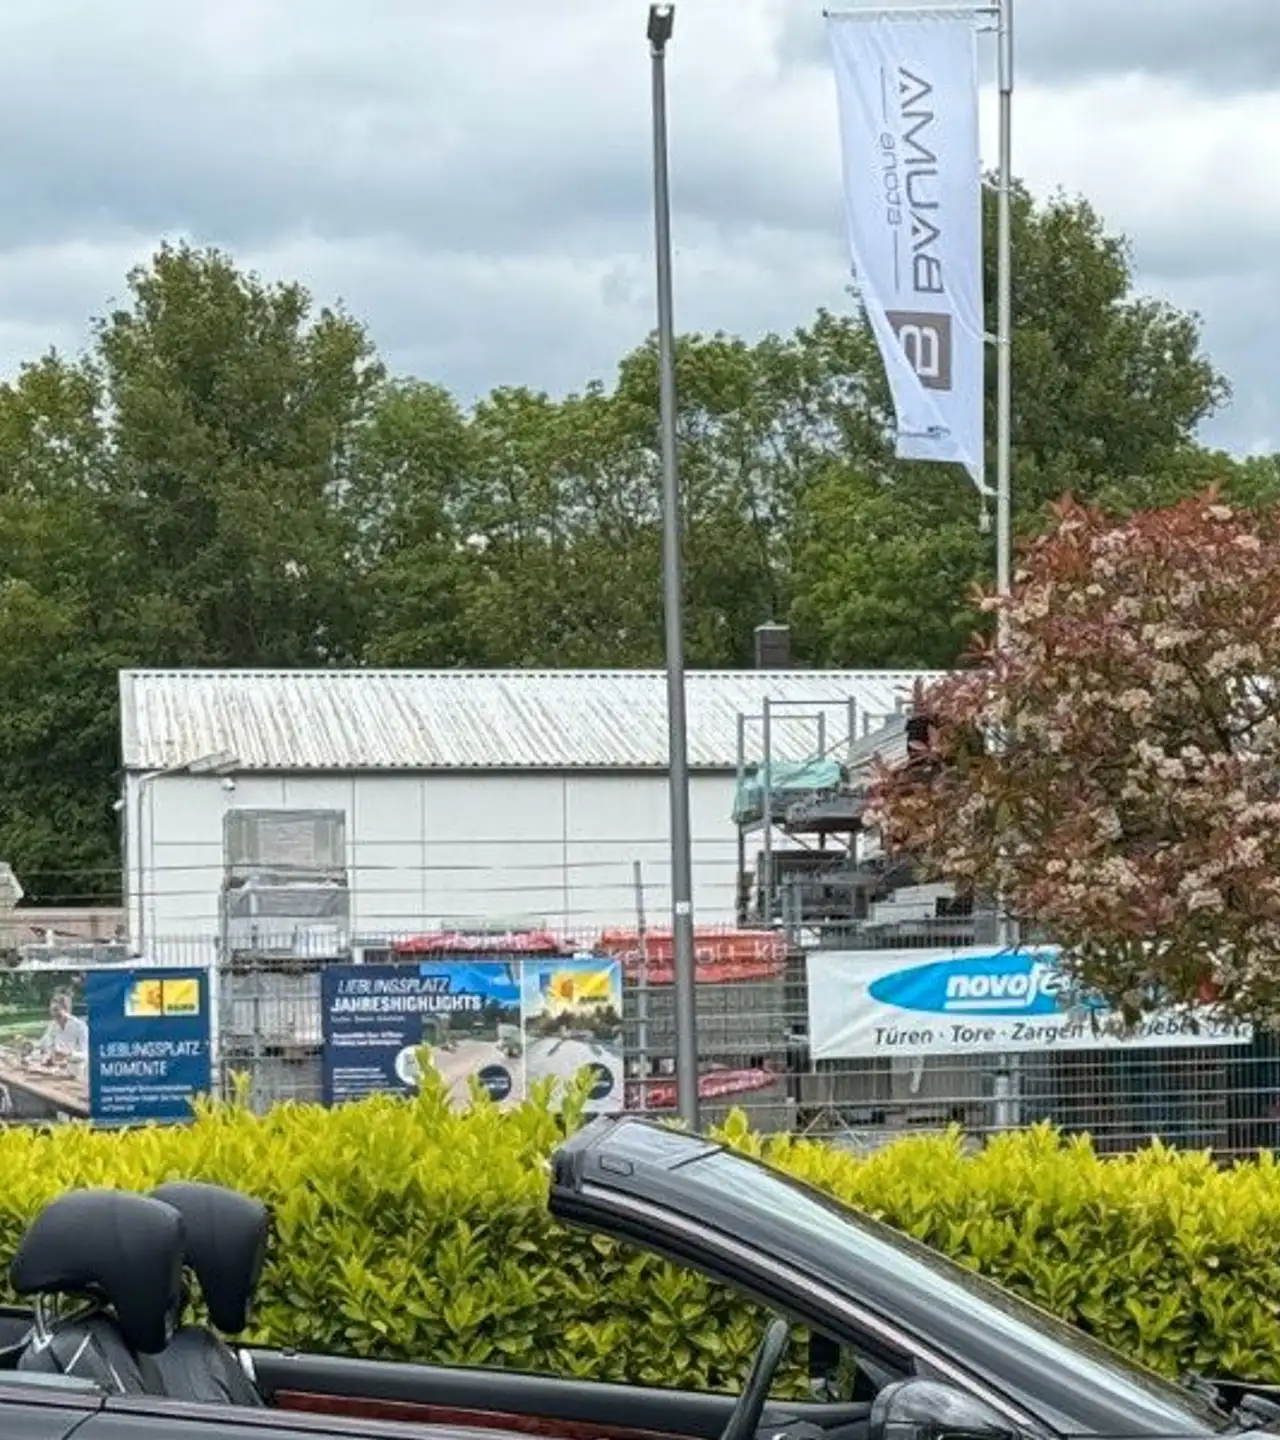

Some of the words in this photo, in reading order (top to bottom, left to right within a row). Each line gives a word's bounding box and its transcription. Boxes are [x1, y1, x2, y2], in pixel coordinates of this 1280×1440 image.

[337, 977, 451, 994] LIEBLINGSPLATZ
[946, 962, 1065, 1006] novofe
[330, 994, 481, 1013] JAHRESHIGHLIGHTS
[874, 1026, 933, 1046] Türen
[951, 1023, 996, 1043] Tore
[1011, 1021, 1085, 1045] Zargen
[99, 1040, 200, 1058] LIEBLINGSPLATZ
[99, 1060, 169, 1077] MOMENTE
